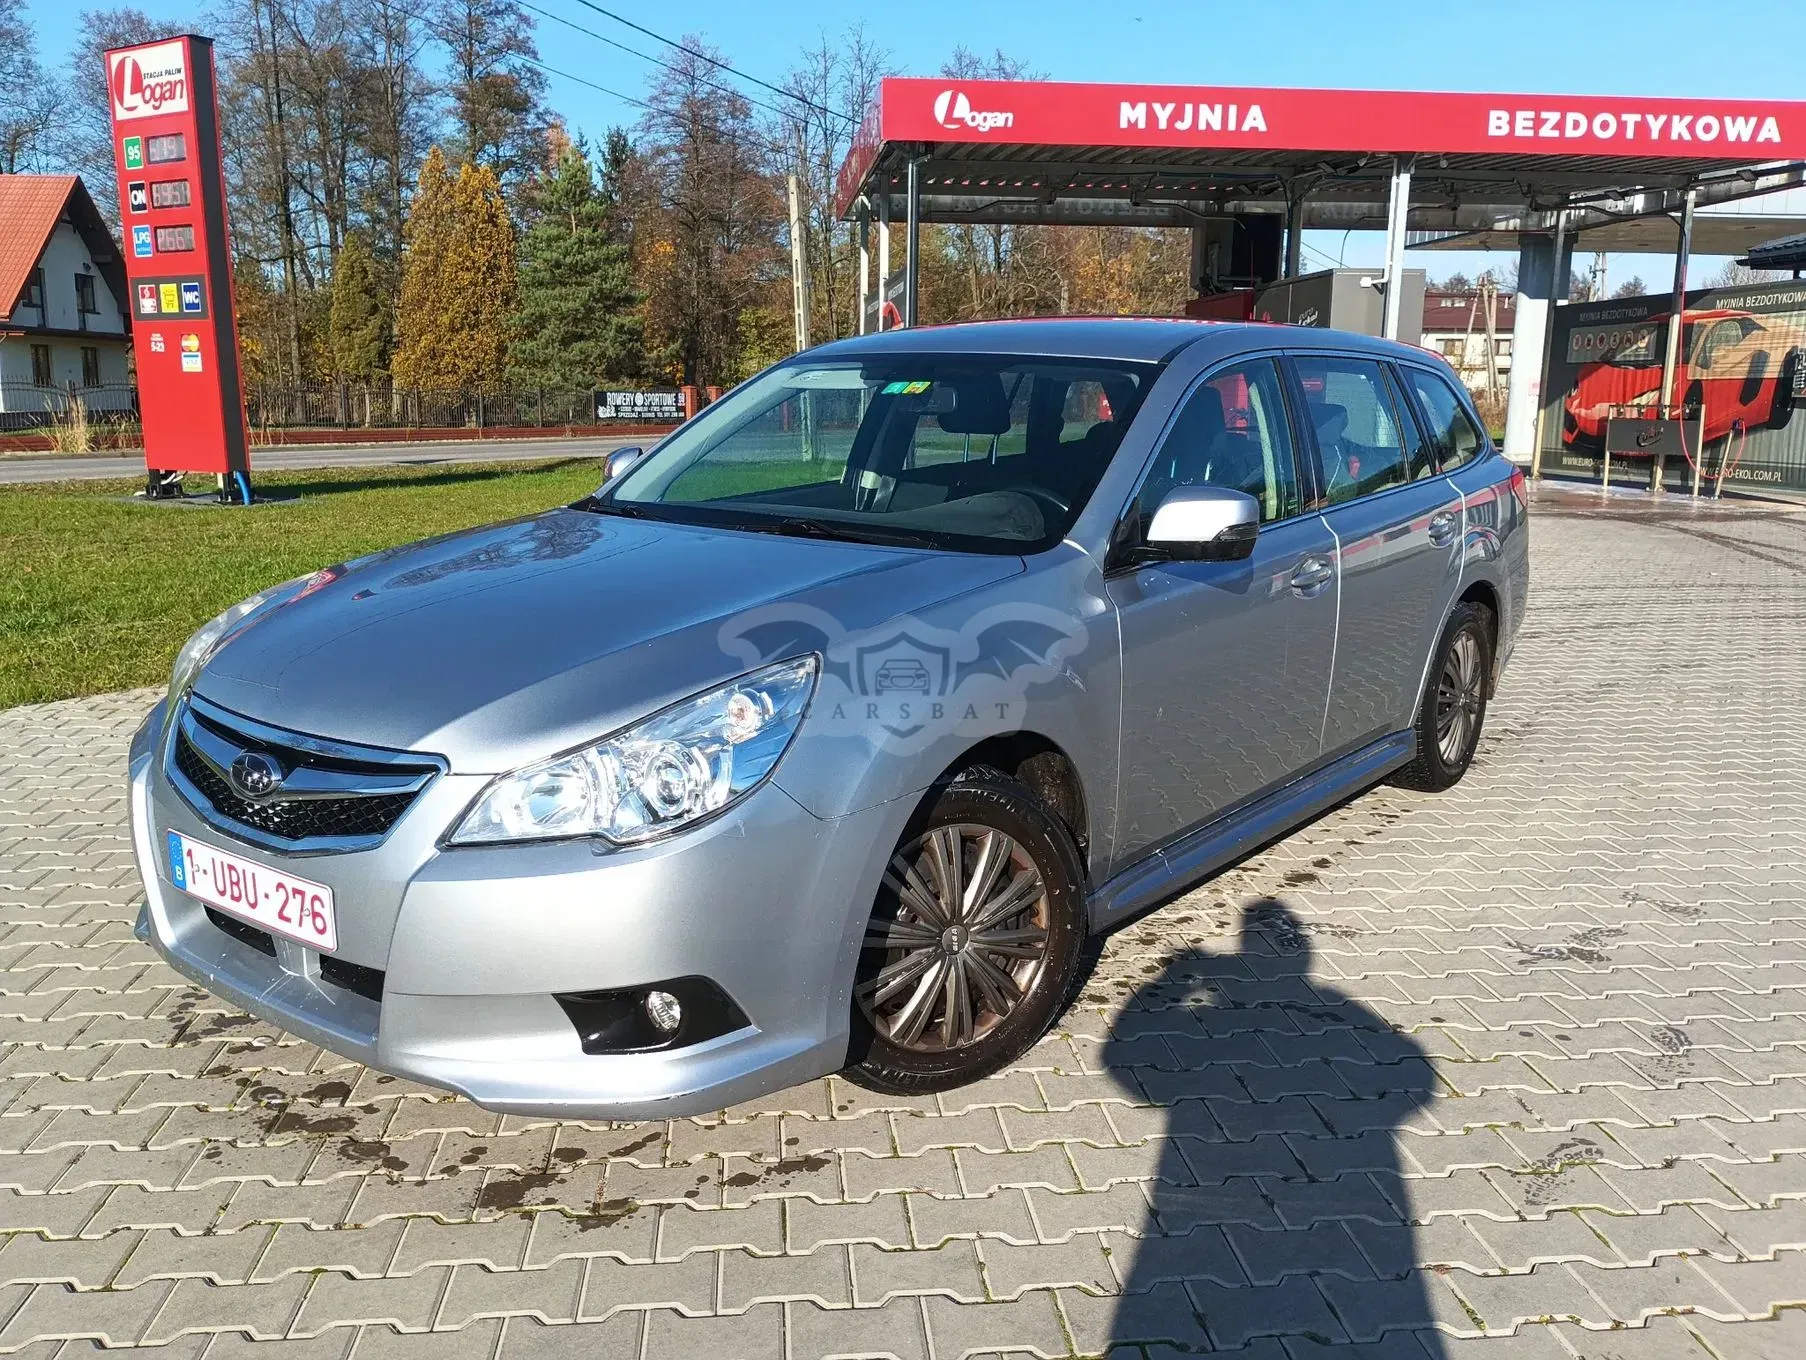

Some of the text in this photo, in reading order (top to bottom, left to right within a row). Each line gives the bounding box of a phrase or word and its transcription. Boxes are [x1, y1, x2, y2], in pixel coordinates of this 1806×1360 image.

[143, 70, 163, 80] STACJA
[114, 56, 184, 111] Logan
[933, 89, 1014, 133] Logan
[1119, 101, 1782, 143] MYJNIA BEZDOTYKOWA
[127, 144, 140, 161] 95
[131, 190, 146, 205] ON
[134, 231, 151, 245] LPG
[184, 291, 199, 304] WC
[1715, 297, 1744, 310] MYJNIA
[606, 392, 634, 406] ROWERY
[644, 392, 676, 406] SPORTOWE
